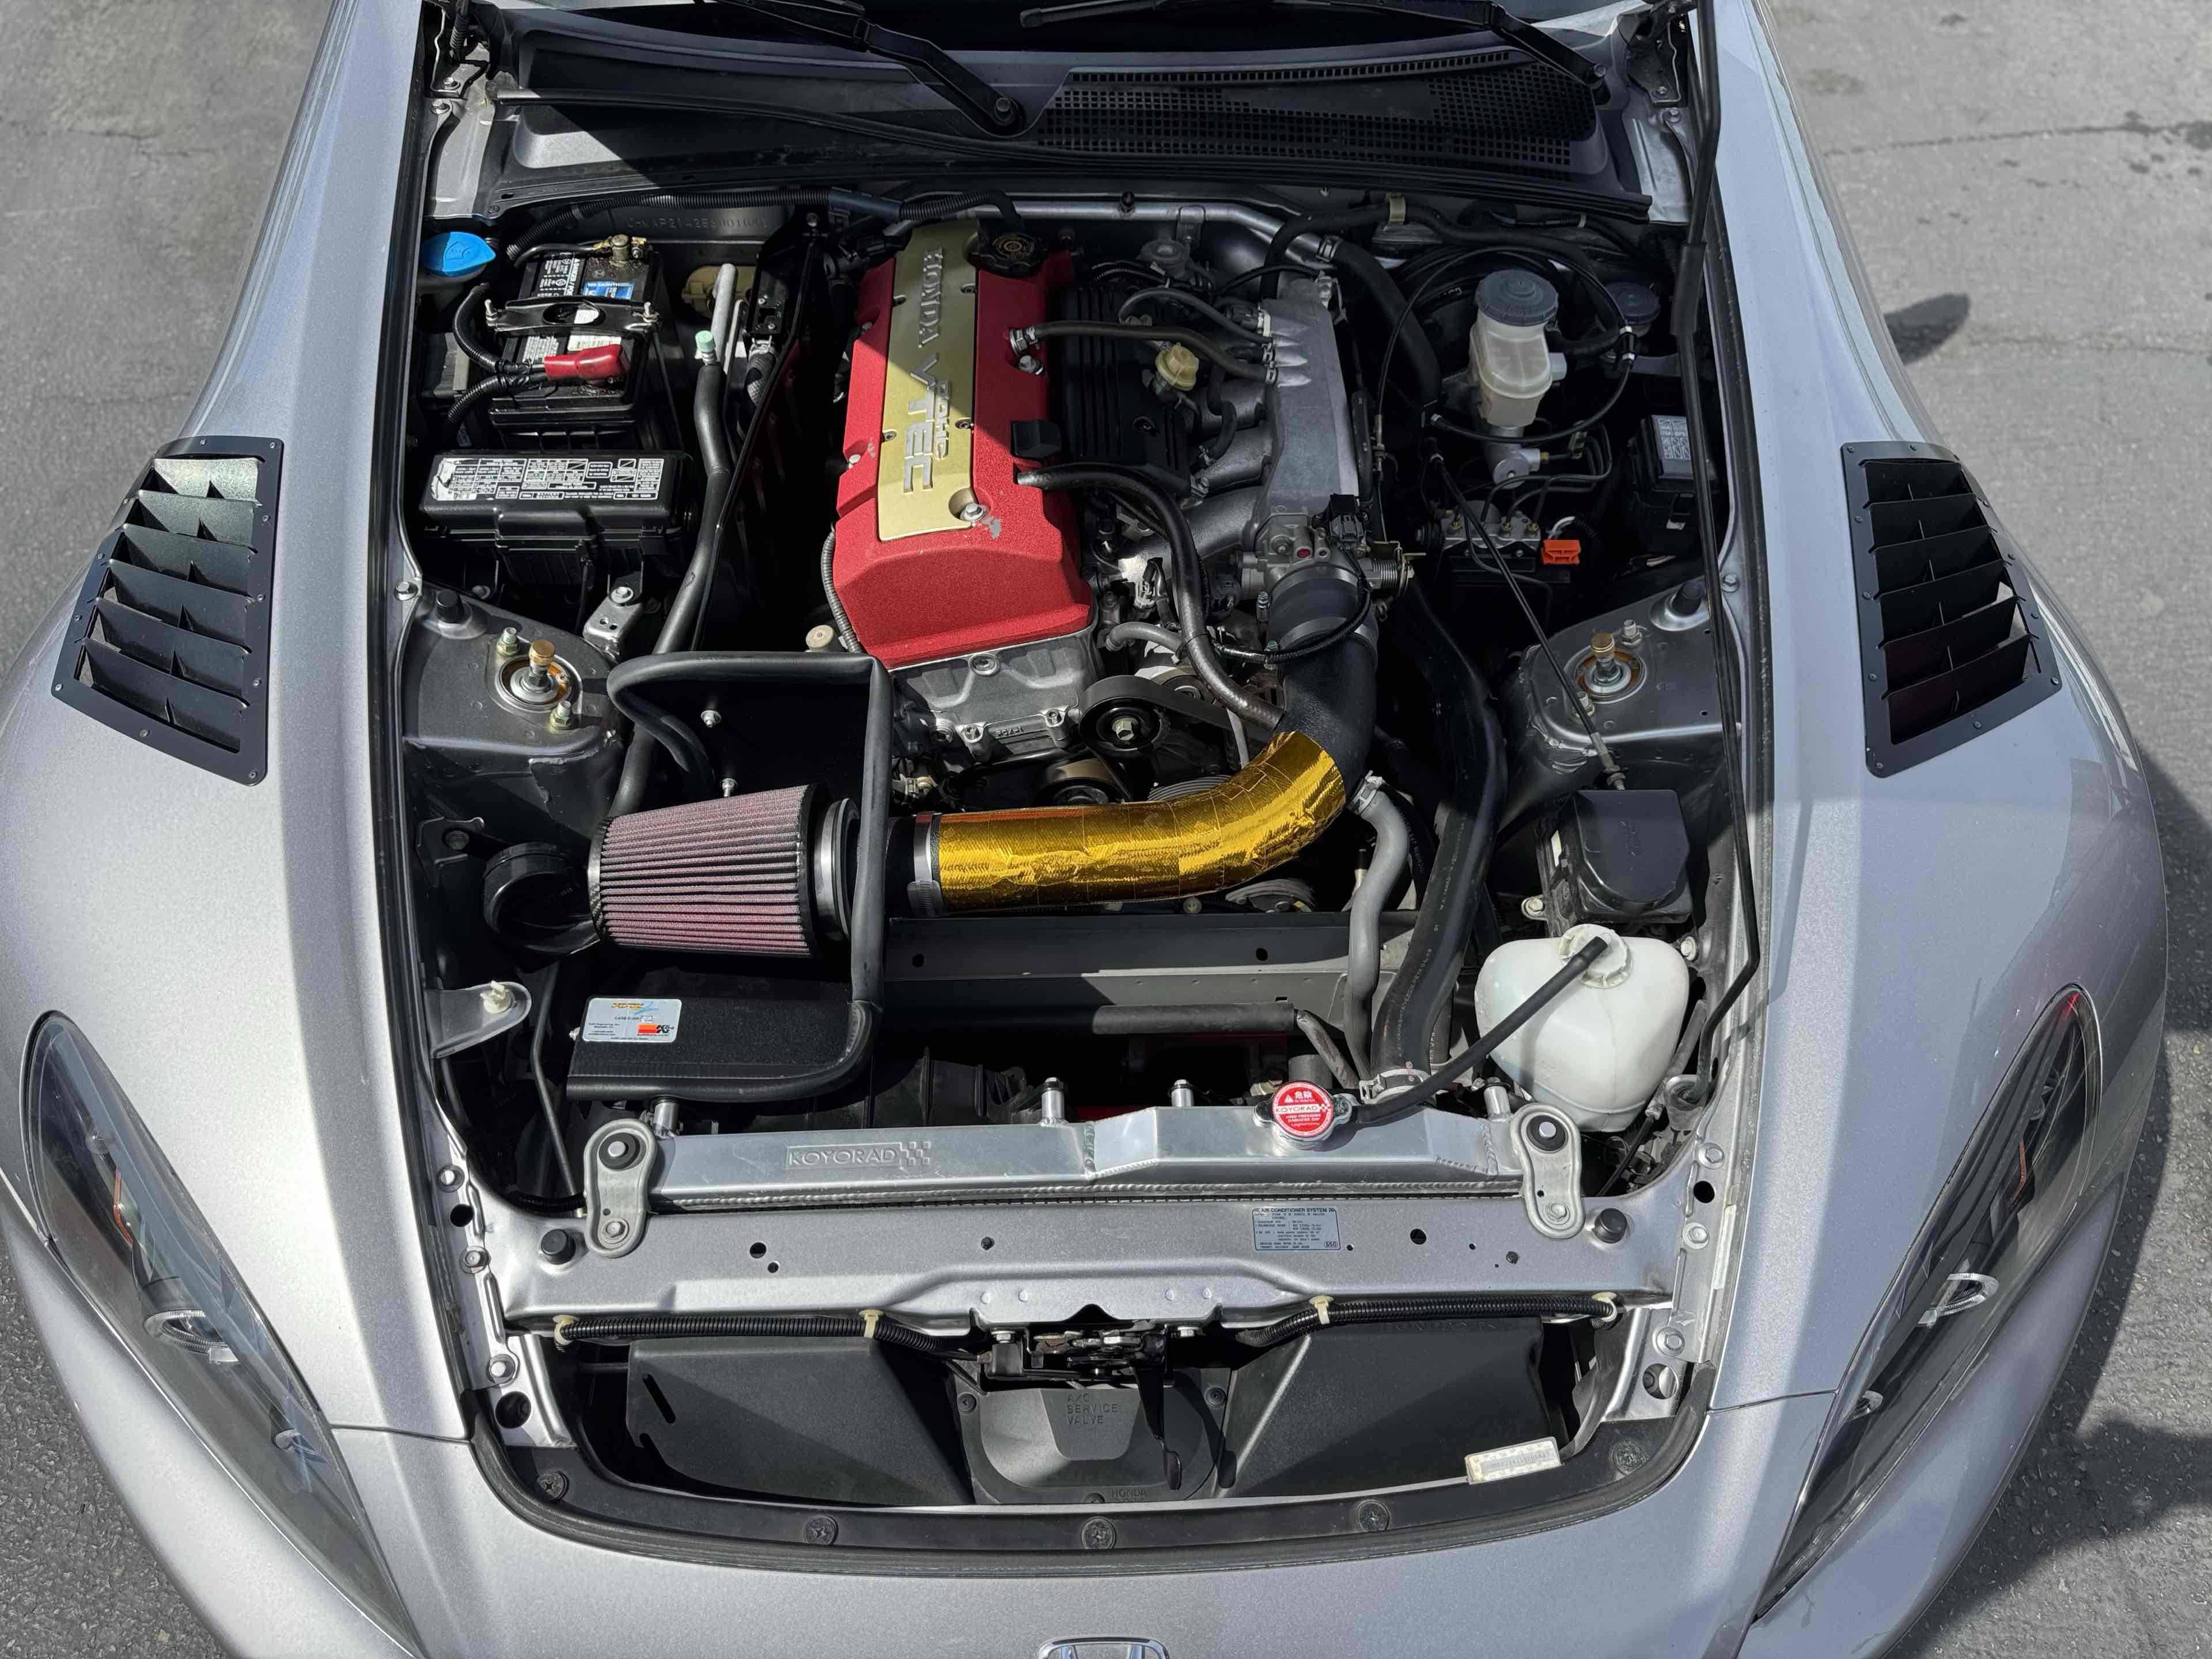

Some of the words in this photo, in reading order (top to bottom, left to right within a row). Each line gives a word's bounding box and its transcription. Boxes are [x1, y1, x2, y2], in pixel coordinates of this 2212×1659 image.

[918, 248, 943, 349] HONDA
[903, 352, 938, 494] VTEC
[934, 378, 950, 461] DOHC
[789, 1147, 896, 1166] KOYORAD
[1067, 1393, 1090, 1402] A/C
[1066, 1403, 1119, 1414] SERVICE
[1068, 1415, 1104, 1425] VALVE
[1111, 1488, 1148, 1497] HONDA
